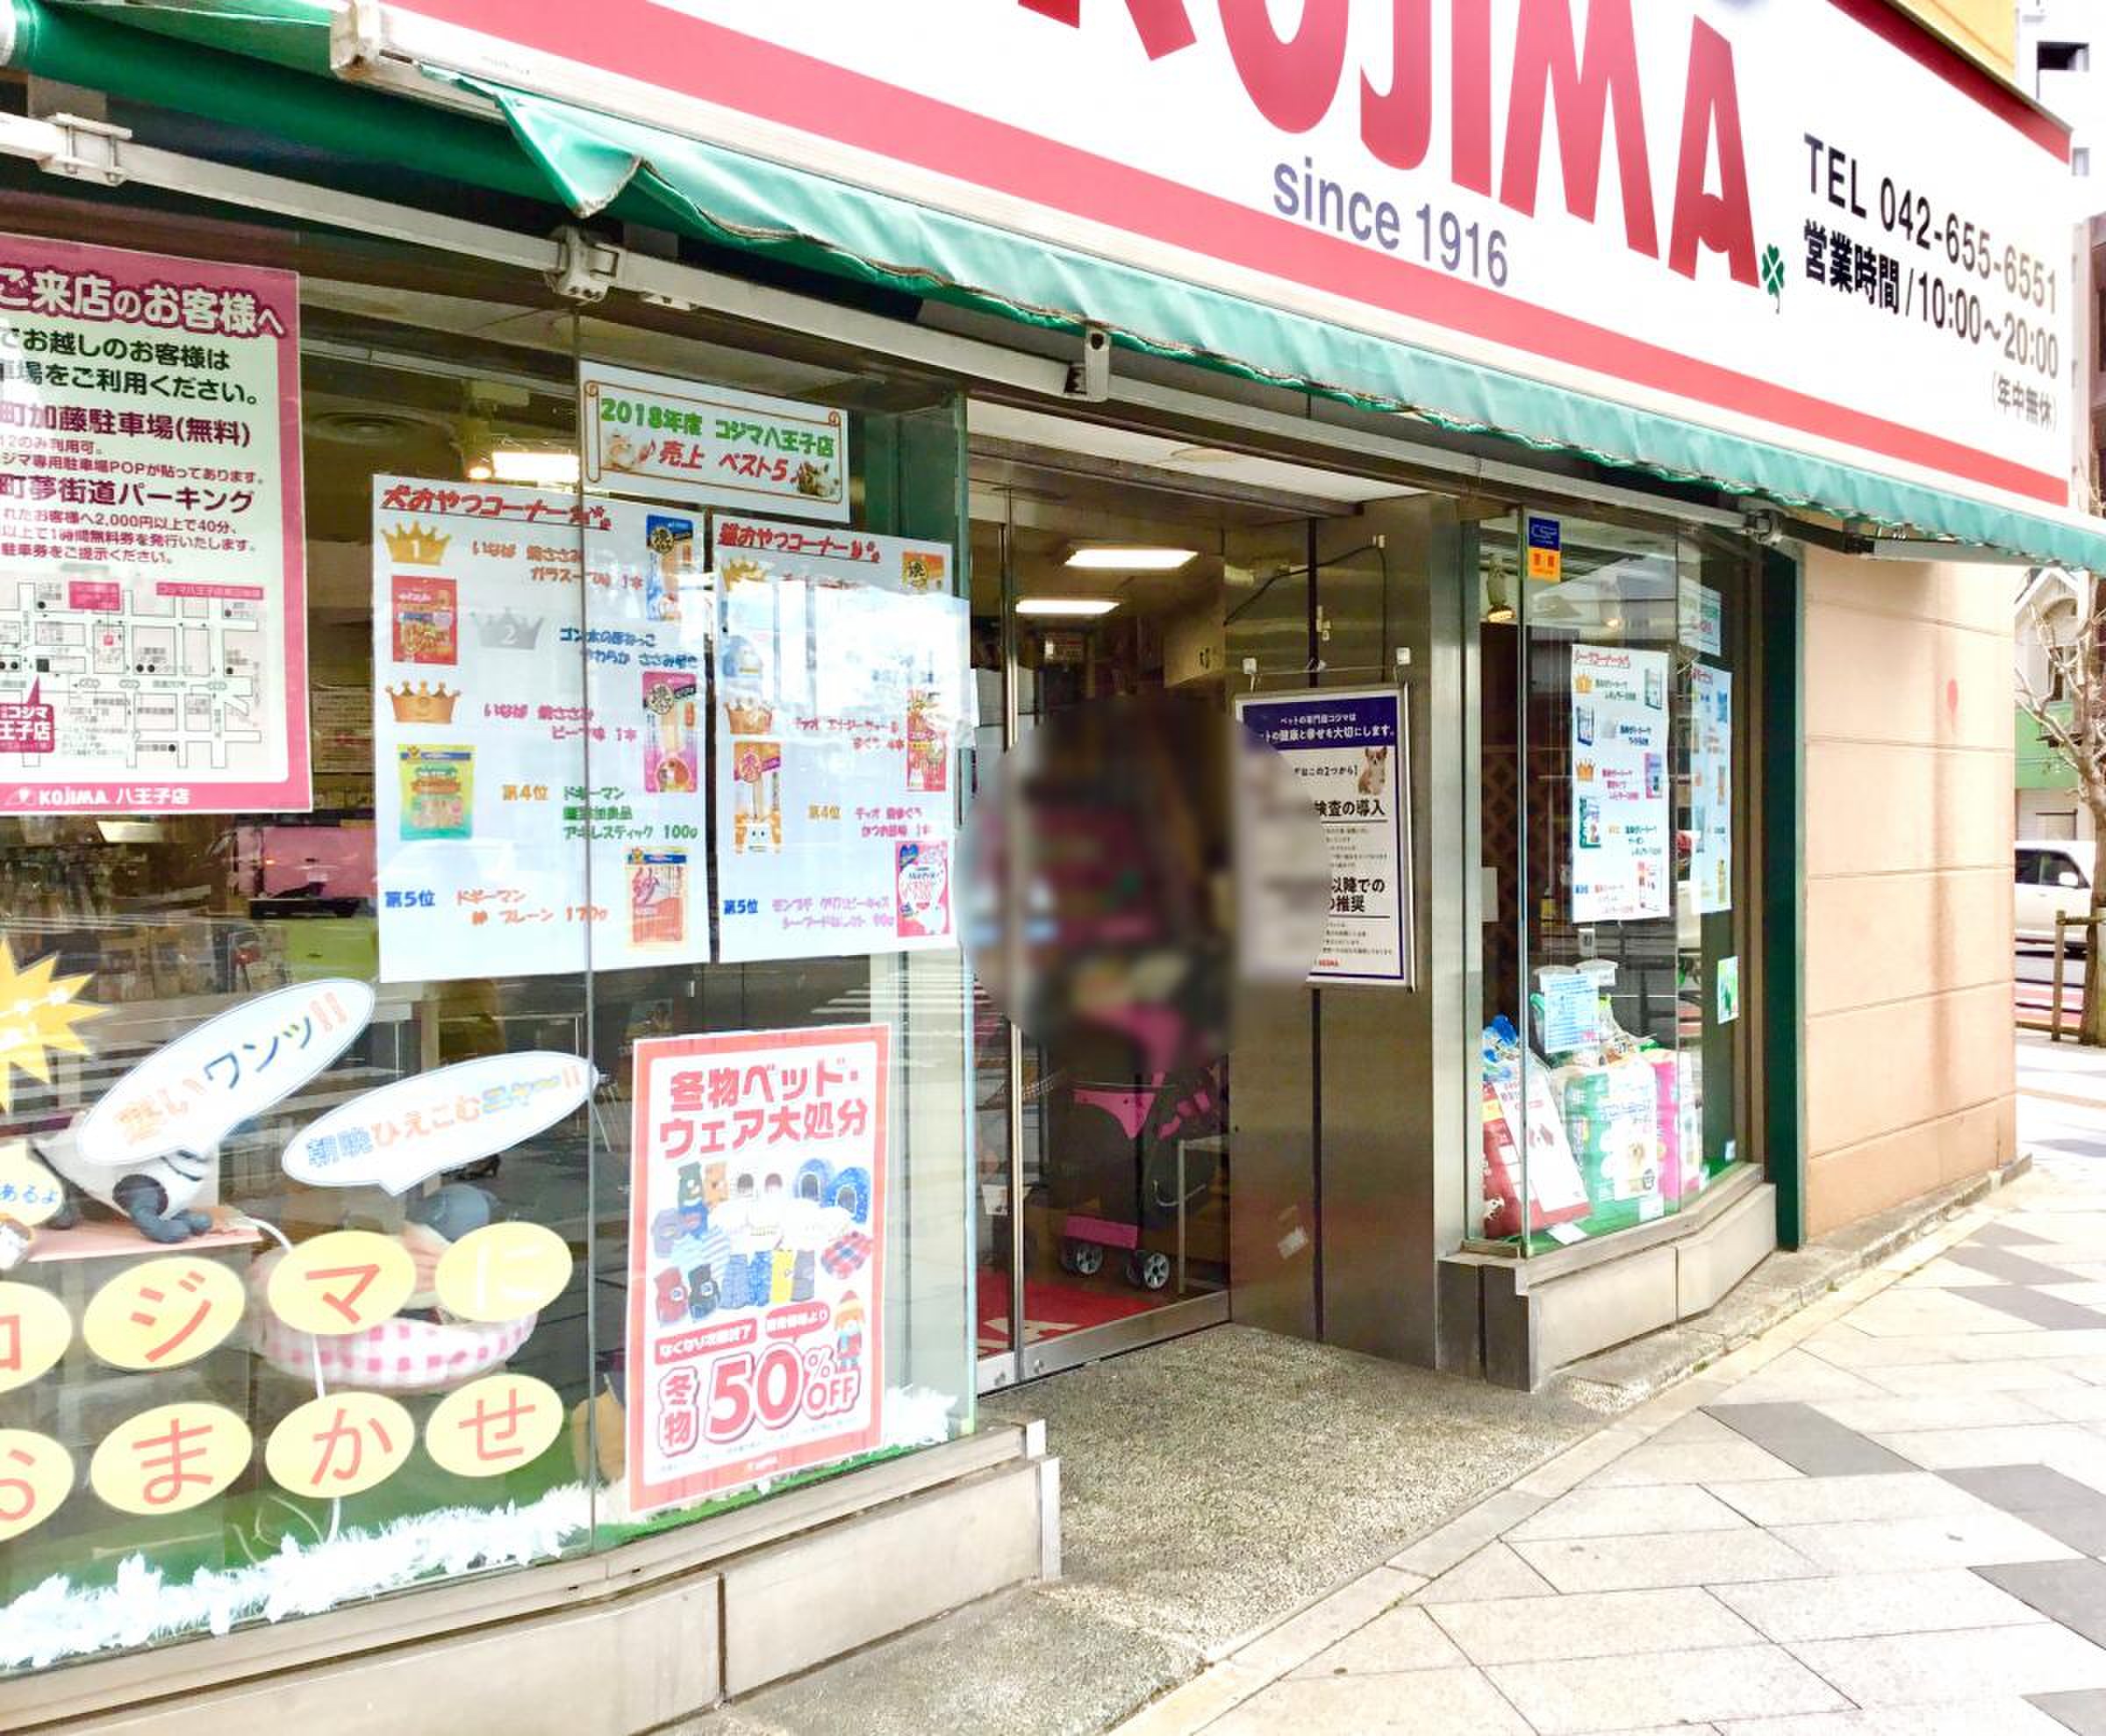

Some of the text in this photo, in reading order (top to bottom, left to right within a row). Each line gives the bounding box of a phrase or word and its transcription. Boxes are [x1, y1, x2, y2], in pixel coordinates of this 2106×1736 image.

[1016, 0, 1759, 288] JIMA
[1274, 156, 1508, 288] since 1916
[1804, 133, 2055, 314] TEL 042-655-6551
[0, 266, 285, 337] ご来店のお客様へ
[601, 398, 835, 458] 2018年度 コジマ八王子店
[659, 440, 705, 469] 売上
[1262, 723, 1395, 743] トの健康と幸せを大切にします。
